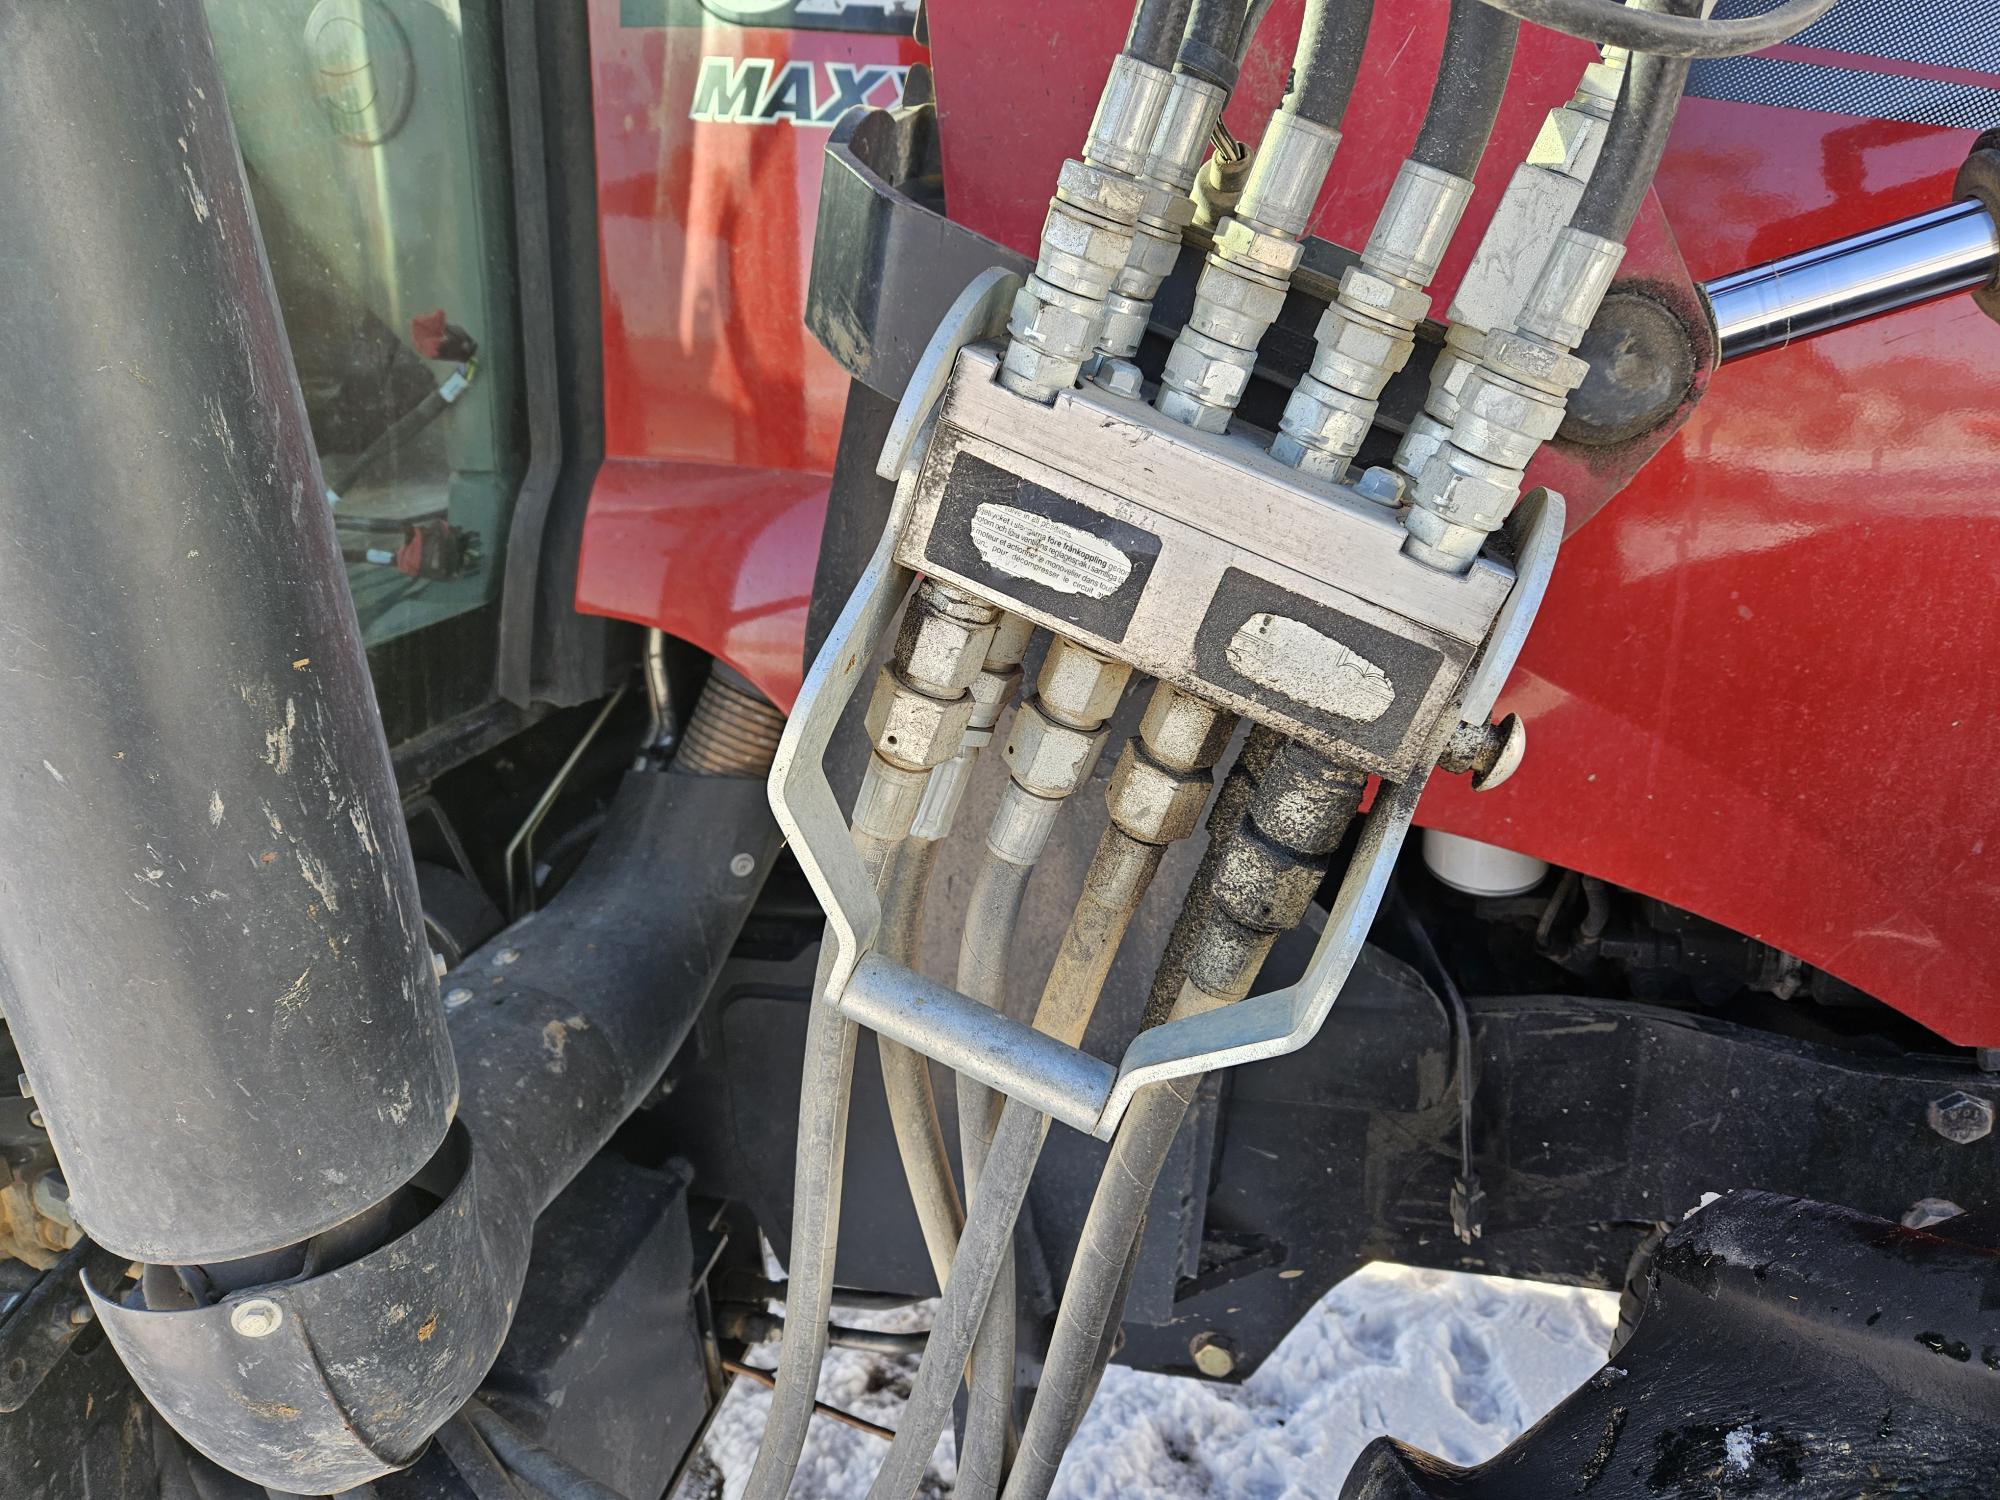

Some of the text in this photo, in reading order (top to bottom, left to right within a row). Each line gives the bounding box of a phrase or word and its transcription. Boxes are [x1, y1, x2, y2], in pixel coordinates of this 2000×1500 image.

[991, 545, 1008, 556] pour
[1072, 580, 1093, 593] circuit
[1081, 575, 1098, 585] dans
